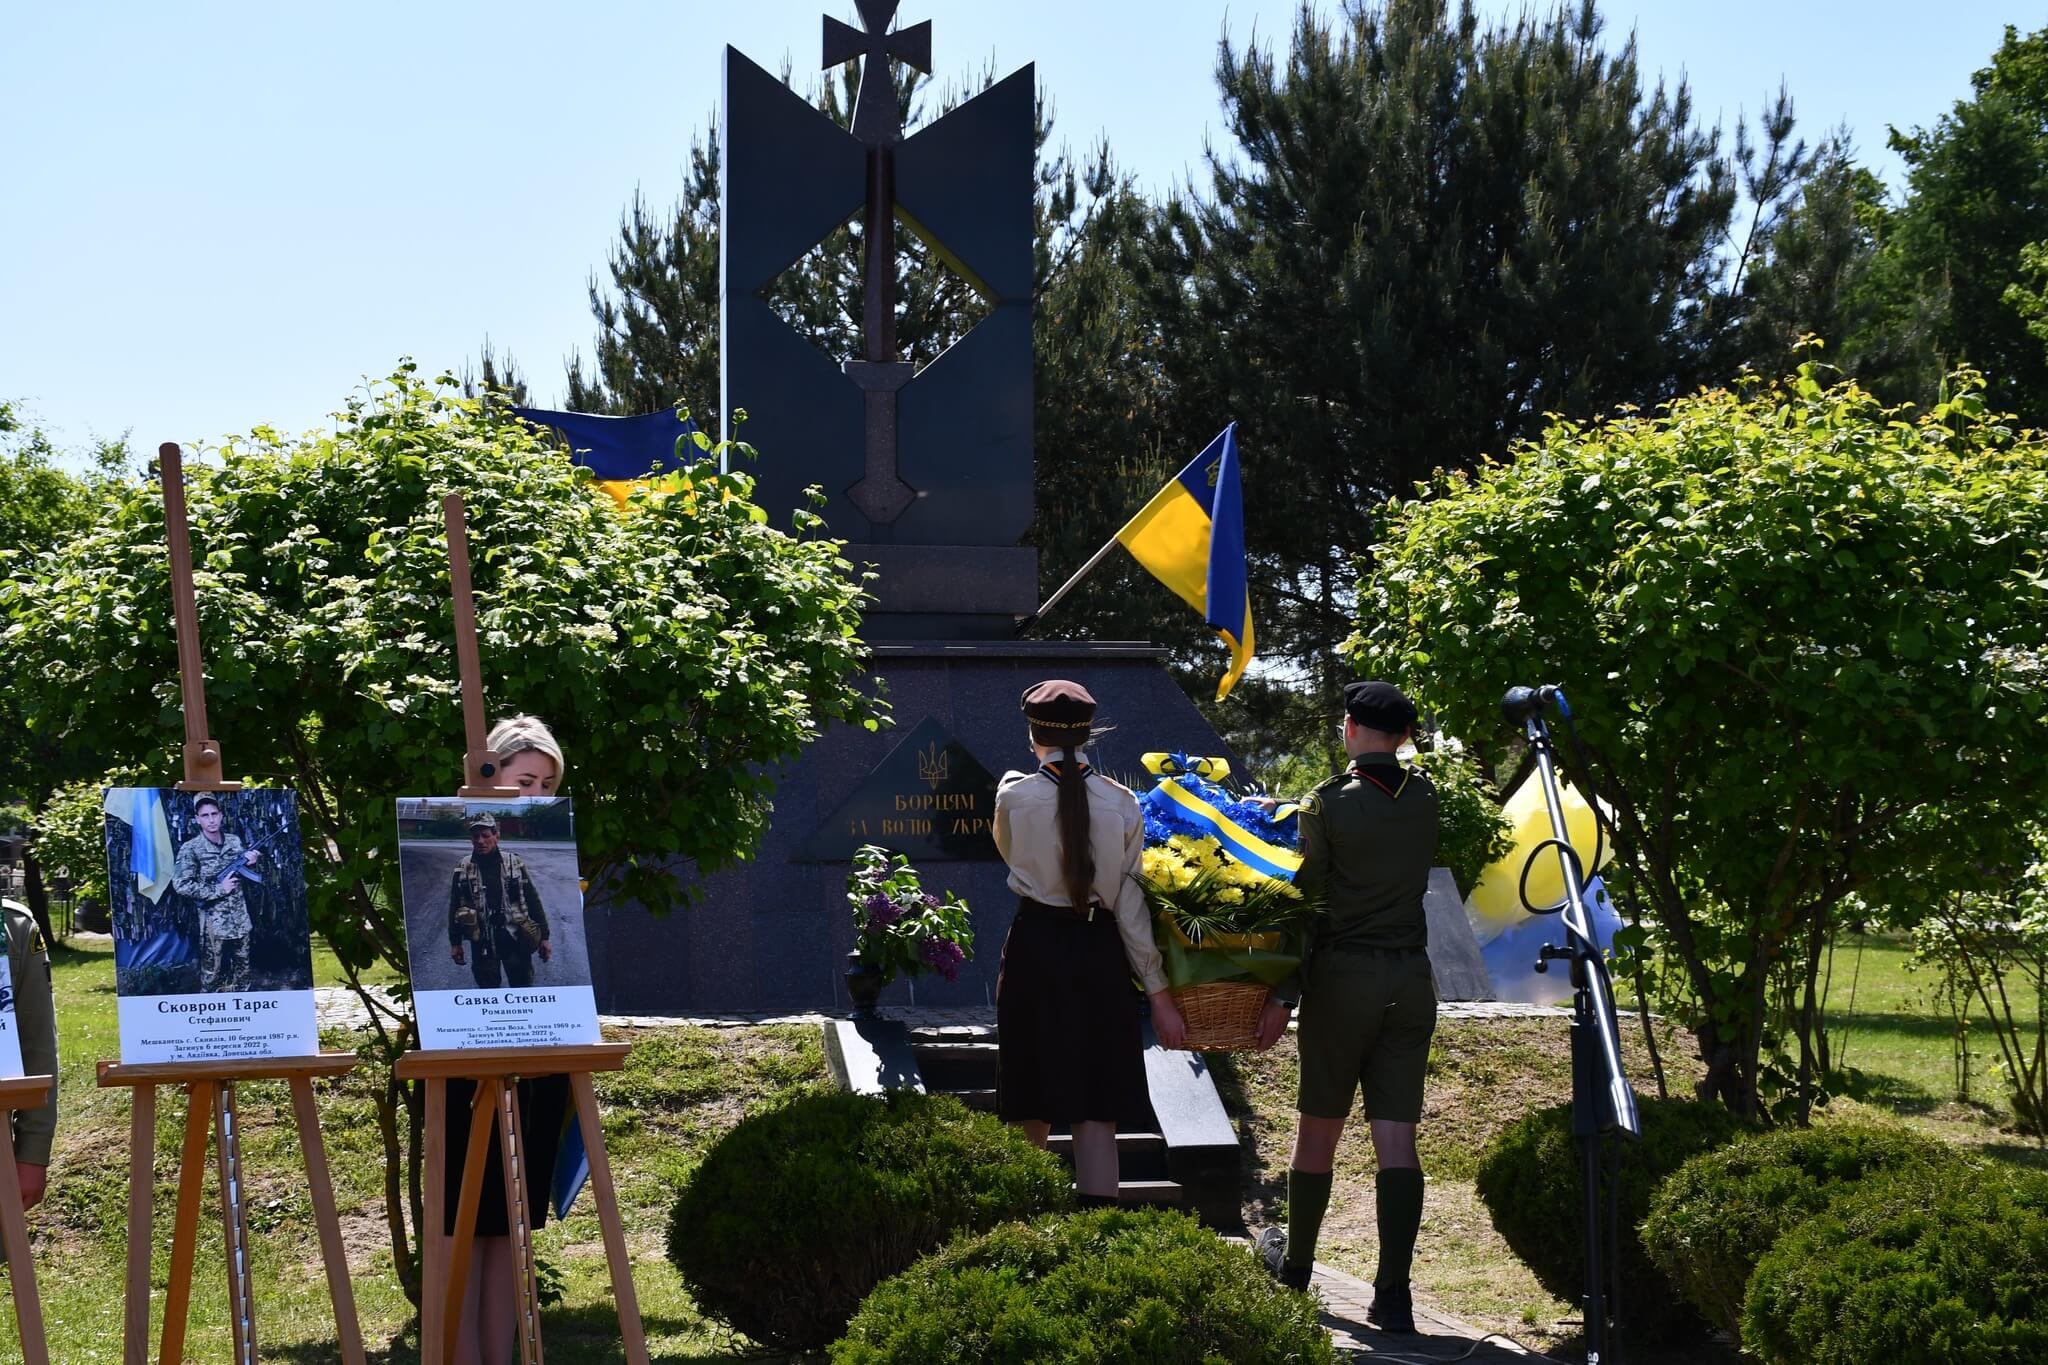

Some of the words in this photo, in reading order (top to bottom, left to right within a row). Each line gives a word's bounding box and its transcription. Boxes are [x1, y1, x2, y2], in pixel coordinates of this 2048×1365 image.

[895, 794, 976, 811] БОРЦЯМ
[952, 818, 994, 835] УКРА
[454, 994, 499, 1006] Савка
[504, 992, 556, 1005] Степан
[158, 1001, 226, 1015] Сковрон
[232, 998, 278, 1012] Тарас
[481, 1008, 533, 1016] Романович
[188, 1016, 251, 1025] Стефанович
[140, 1038, 184, 1046] Мешканець
[239, 1034, 267, 1042] березня
[174, 1044, 204, 1052] Загинув
[213, 1043, 242, 1051] вересня
